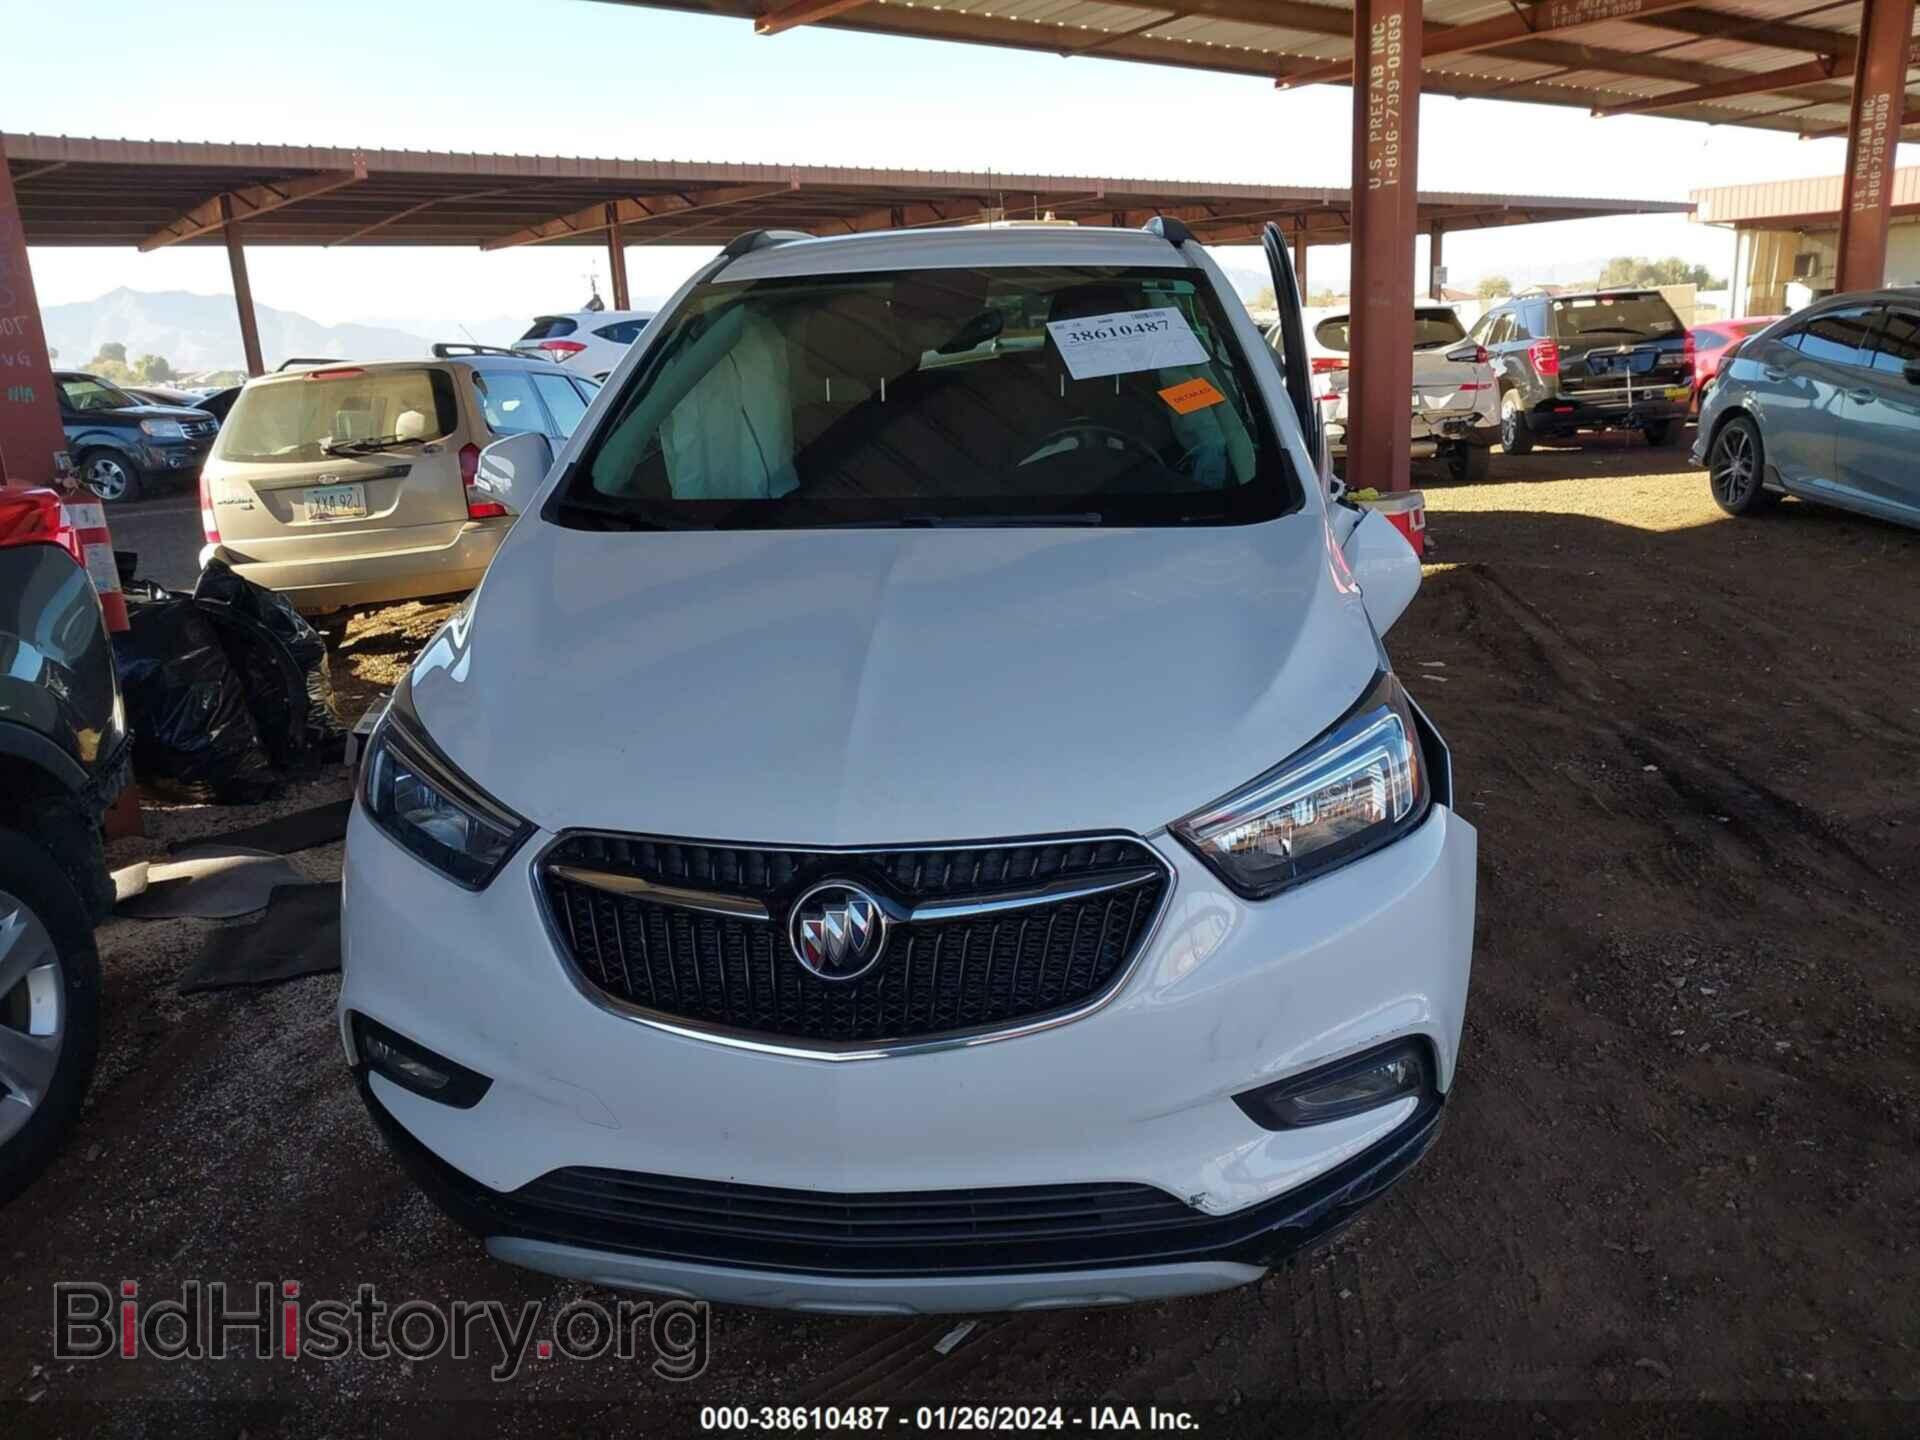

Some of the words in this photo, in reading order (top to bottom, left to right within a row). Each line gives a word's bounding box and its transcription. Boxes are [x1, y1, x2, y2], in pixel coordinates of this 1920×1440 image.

[1372, 15, 1386, 55] INC.
[1370, 64, 1385, 142] PREFAB
[1384, 14, 1402, 186] 1-866-799-0969
[1369, 152, 1383, 190] U.S.
[1856, 127, 1873, 179] PREFAB
[1068, 319, 1170, 345] 38610487
